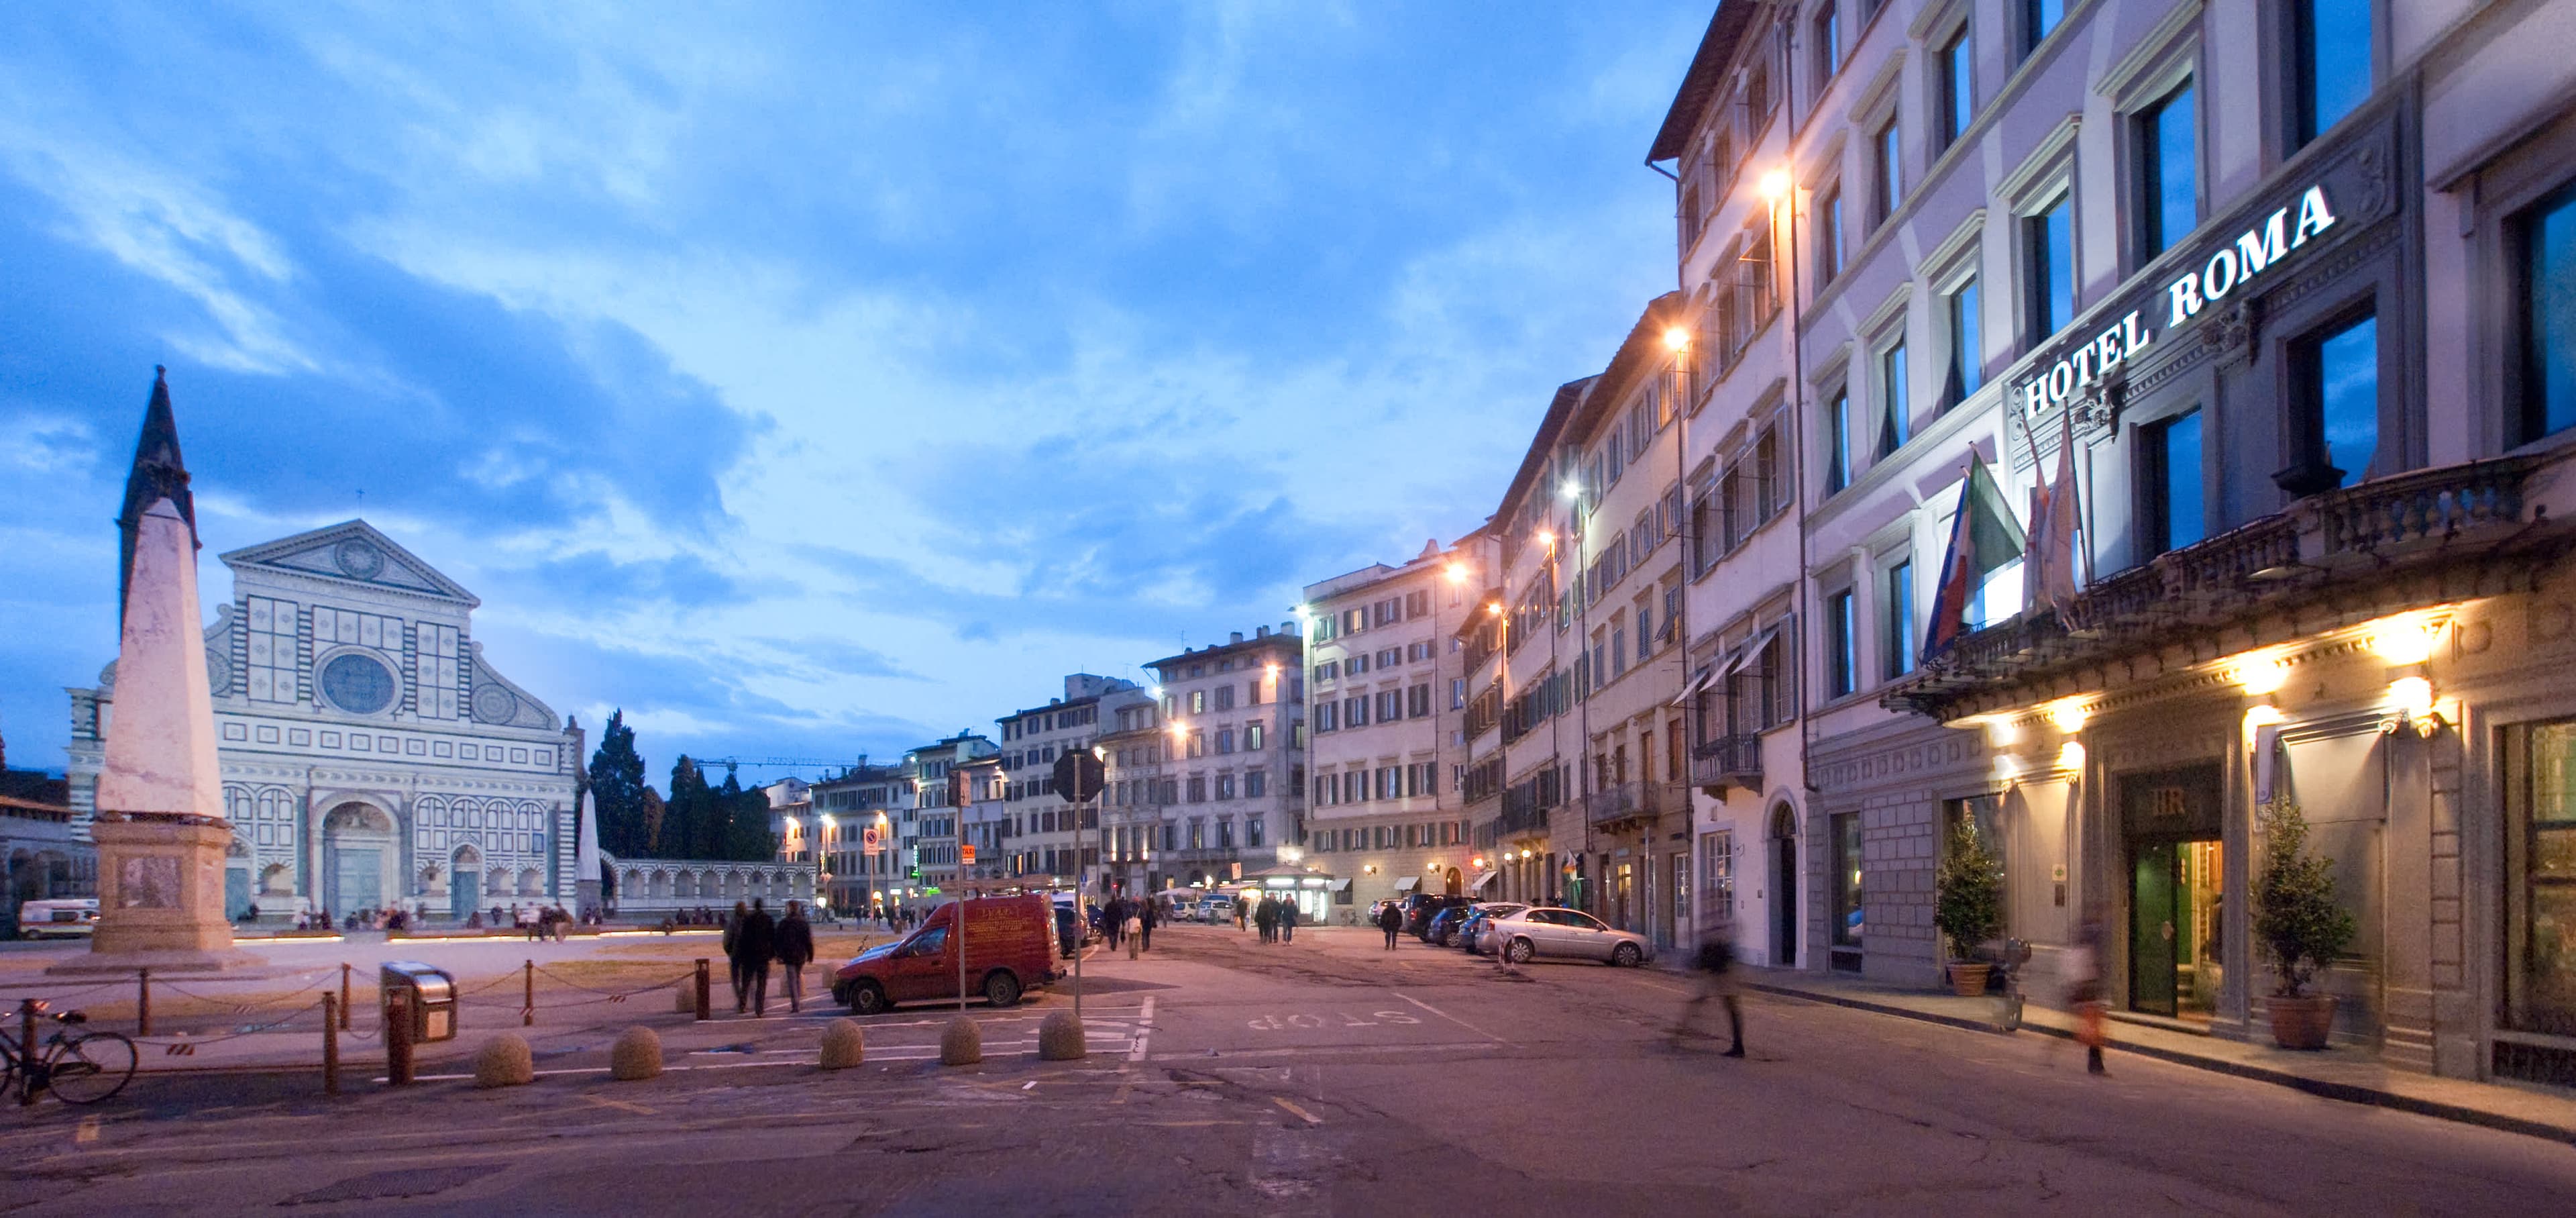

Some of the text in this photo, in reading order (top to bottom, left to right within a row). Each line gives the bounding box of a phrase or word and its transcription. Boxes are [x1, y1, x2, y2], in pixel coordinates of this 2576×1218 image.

[2024, 185, 2336, 421] HOTEL ROMA
[1247, 1011, 1421, 1030] STOP
